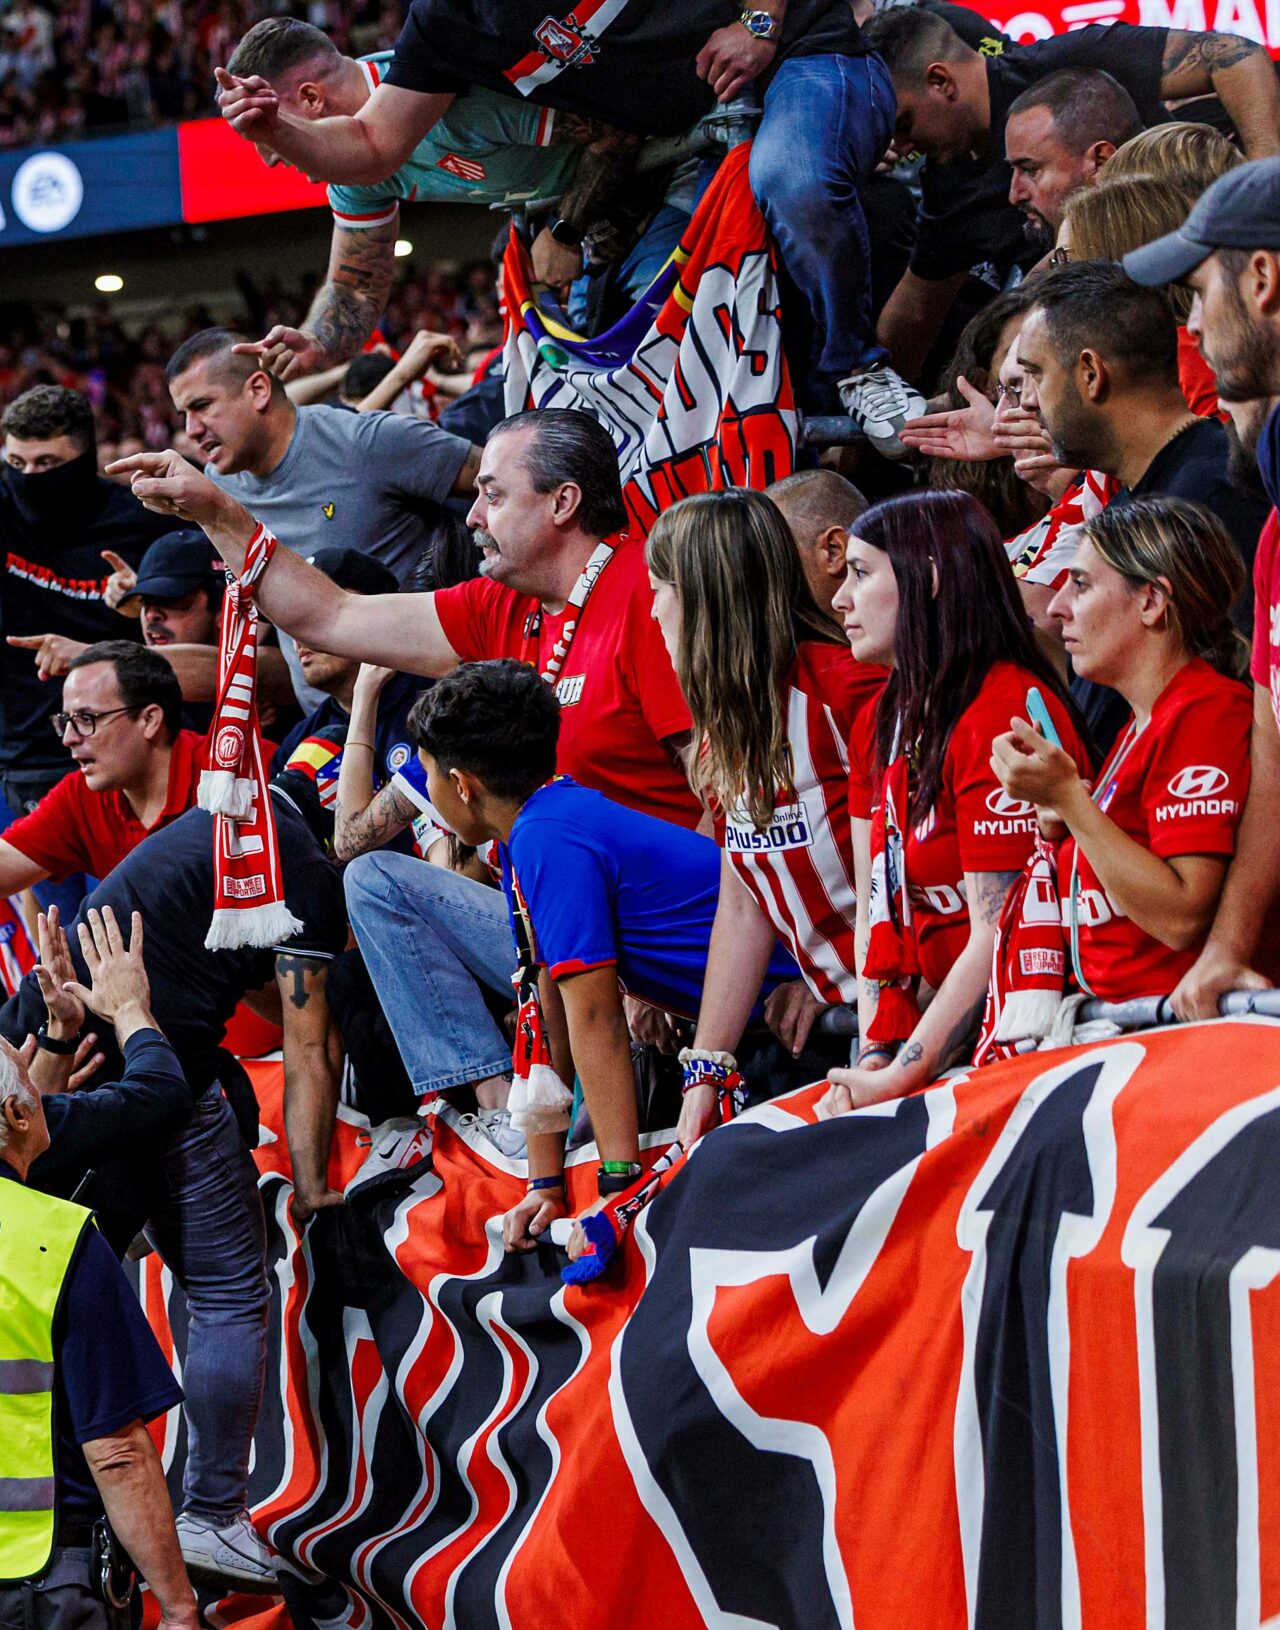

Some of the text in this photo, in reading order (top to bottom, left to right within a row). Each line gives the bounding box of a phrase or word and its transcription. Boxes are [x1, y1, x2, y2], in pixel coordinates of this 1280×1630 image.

[772, 811, 803, 824] Online
[1155, 799, 1239, 823] HYUNDAI
[973, 818, 1038, 836] HYUND
